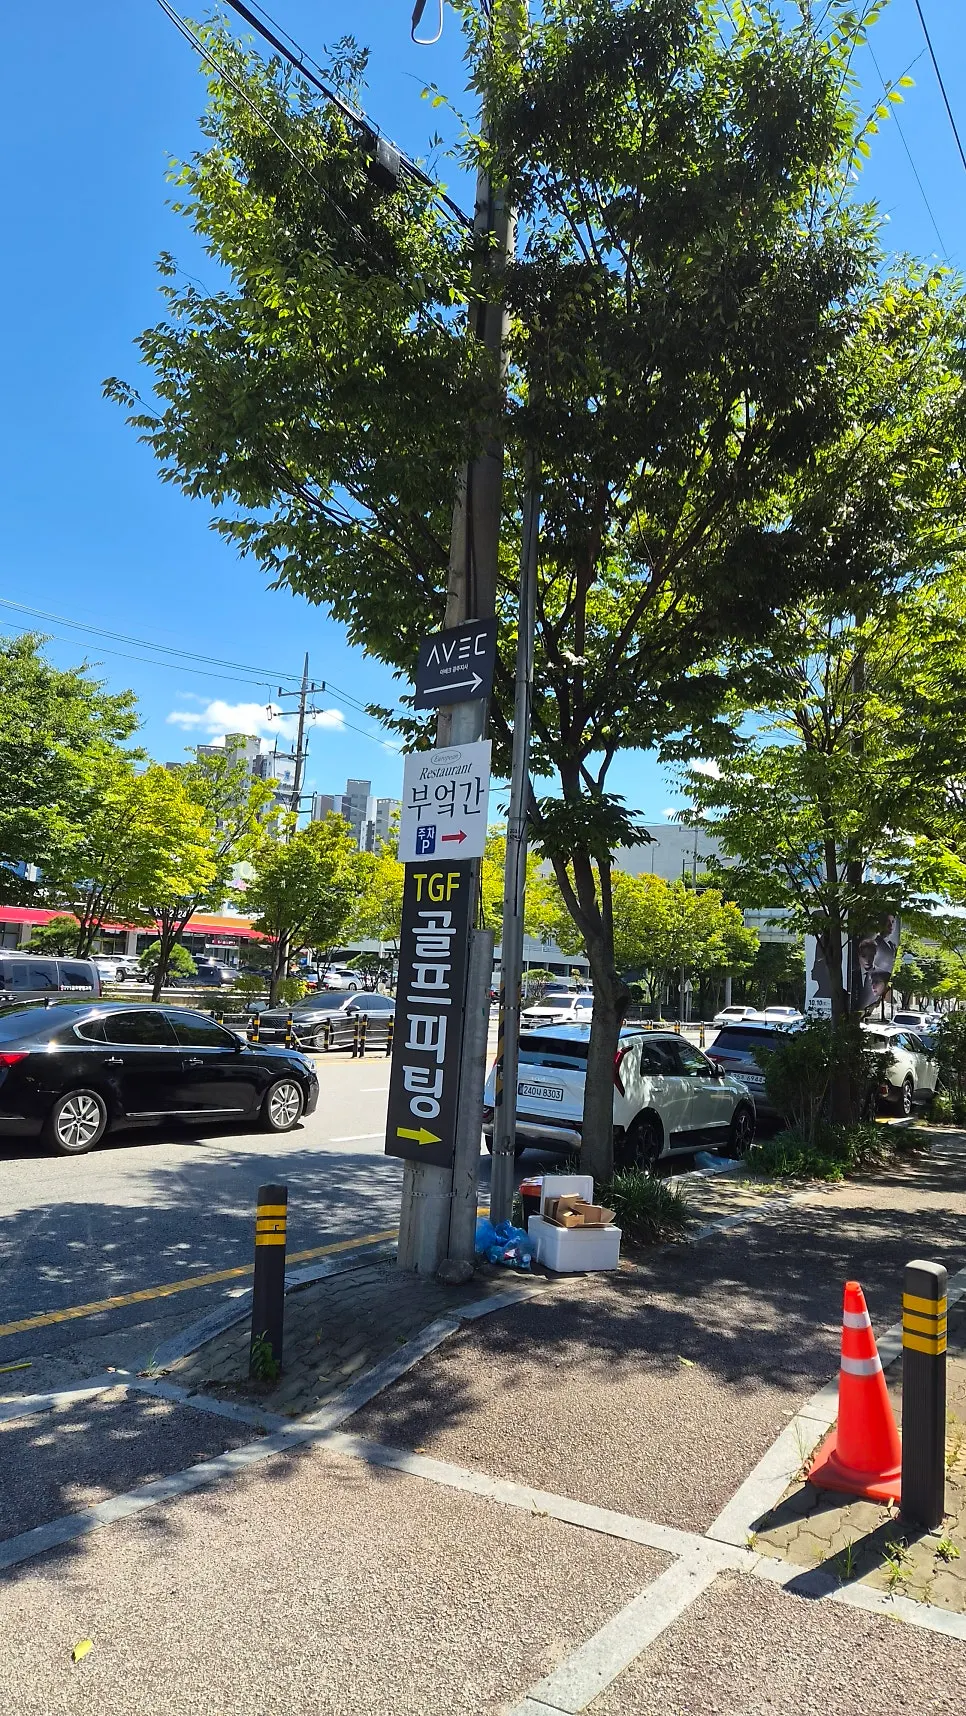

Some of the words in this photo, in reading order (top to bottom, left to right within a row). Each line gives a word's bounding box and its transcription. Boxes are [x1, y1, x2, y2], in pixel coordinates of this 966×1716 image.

[426, 632, 488, 667] AVEC
[419, 762, 473, 781] Restaurant
[417, 826, 436, 840] 주차
[421, 839, 430, 853] P
[413, 872, 461, 902] TGF
[542, 1088, 561, 1099] 8303
